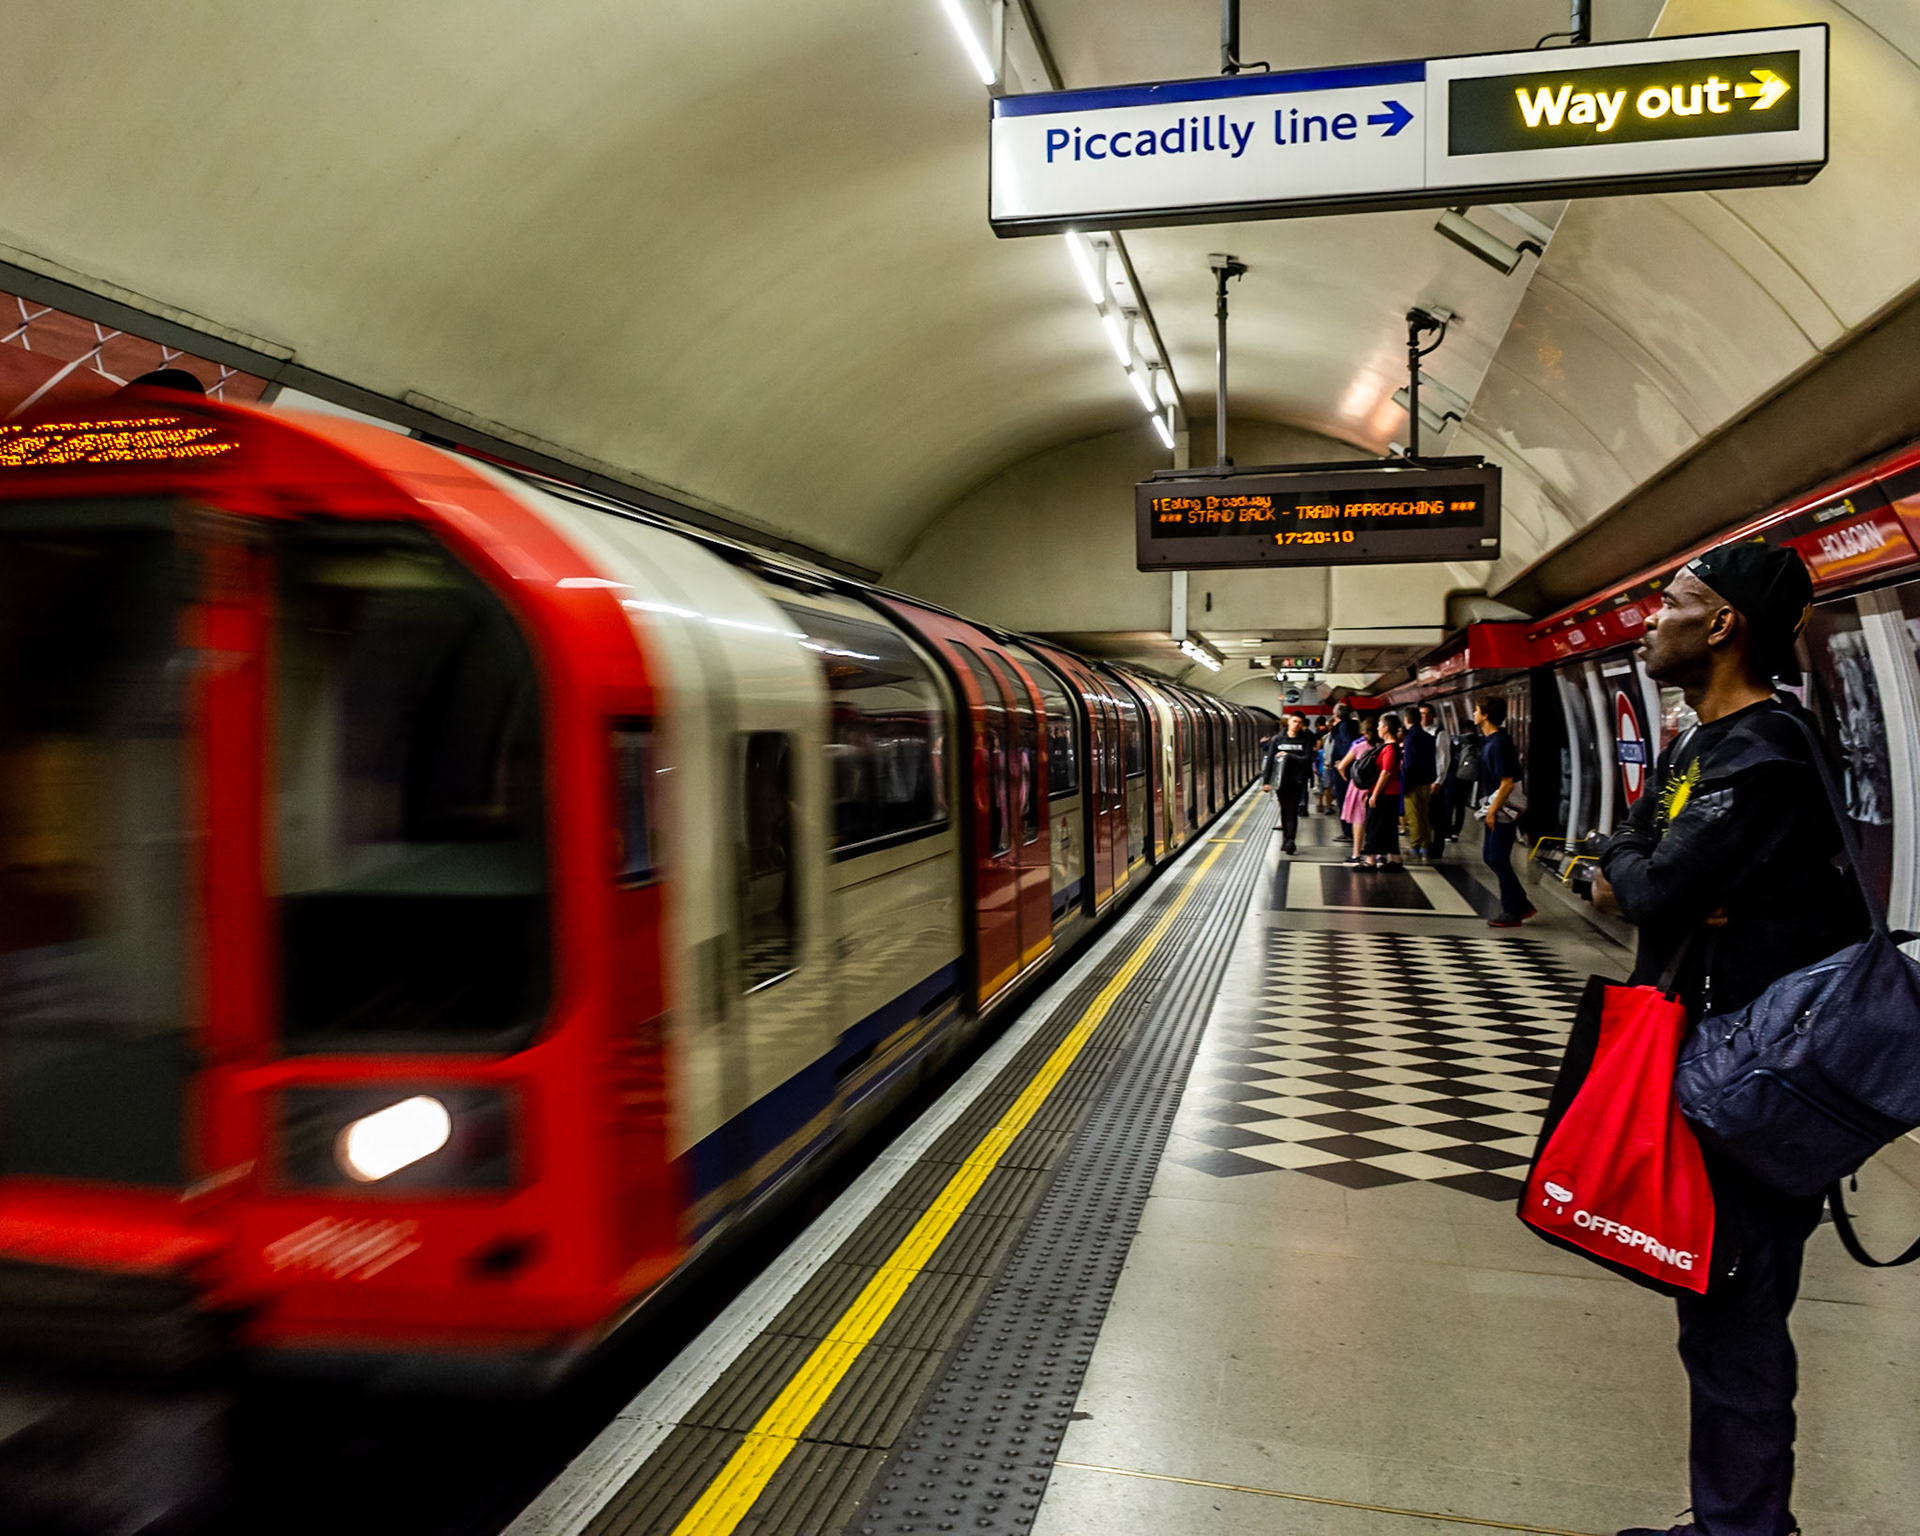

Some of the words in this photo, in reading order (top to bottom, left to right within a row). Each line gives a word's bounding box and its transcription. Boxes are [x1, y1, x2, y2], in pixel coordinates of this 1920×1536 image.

[1515, 82, 1628, 133] Way
[1635, 75, 1732, 119] out
[1047, 114, 1256, 164] Piccadilly
[1275, 107, 1358, 146] line
[1160, 497, 1202, 512] Ealing
[1205, 495, 1273, 509] Broadway
[1187, 508, 1236, 524] STAND
[1238, 507, 1277, 523] BACK
[1295, 504, 1341, 520] TRAIN
[1343, 500, 1445, 518] APPROACHING
[1274, 530, 1356, 546] 17:20:10
[1817, 520, 1887, 562] HOLBORN
